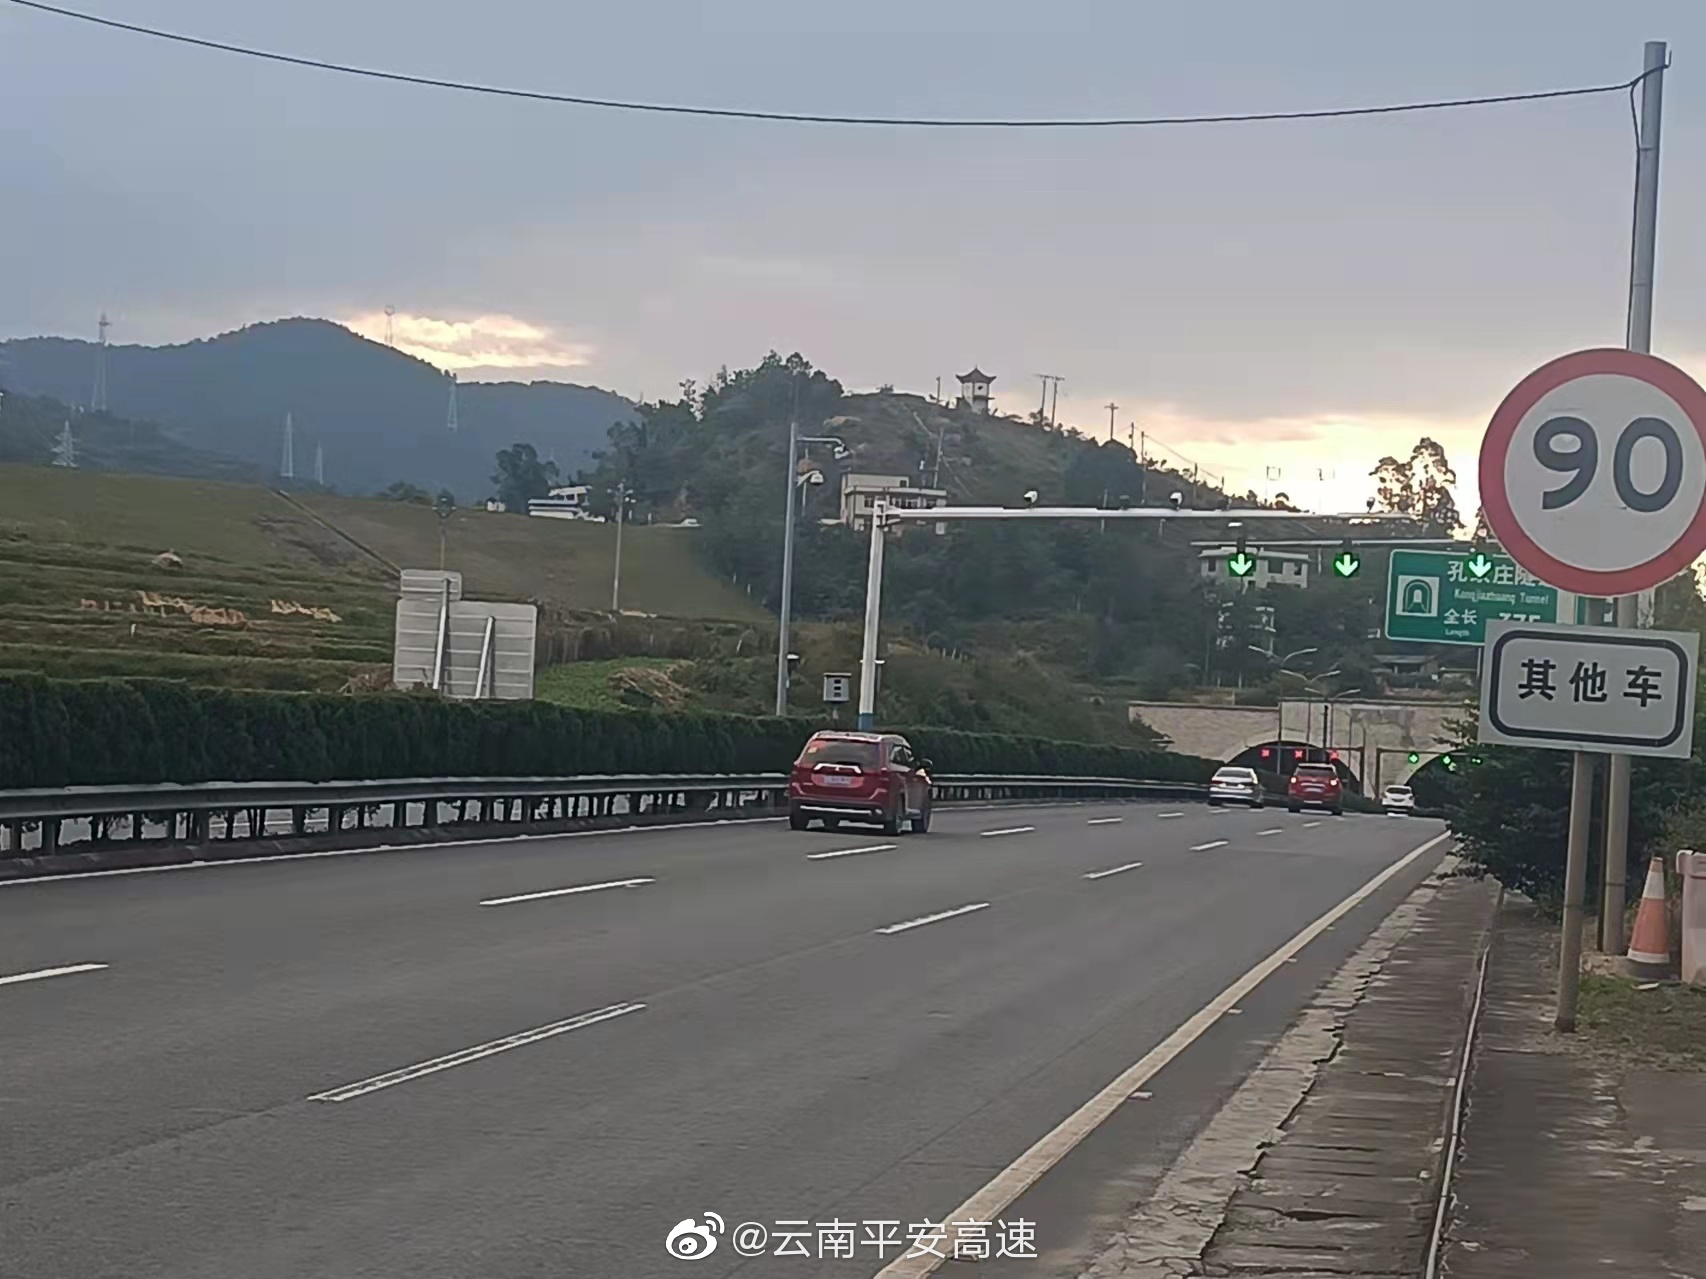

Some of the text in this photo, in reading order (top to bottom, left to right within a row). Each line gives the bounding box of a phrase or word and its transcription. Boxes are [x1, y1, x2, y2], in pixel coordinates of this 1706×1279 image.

[1533, 415, 1683, 513] 90
[1443, 607, 1478, 625] 全长
[1518, 658, 1662, 708] 其他车
